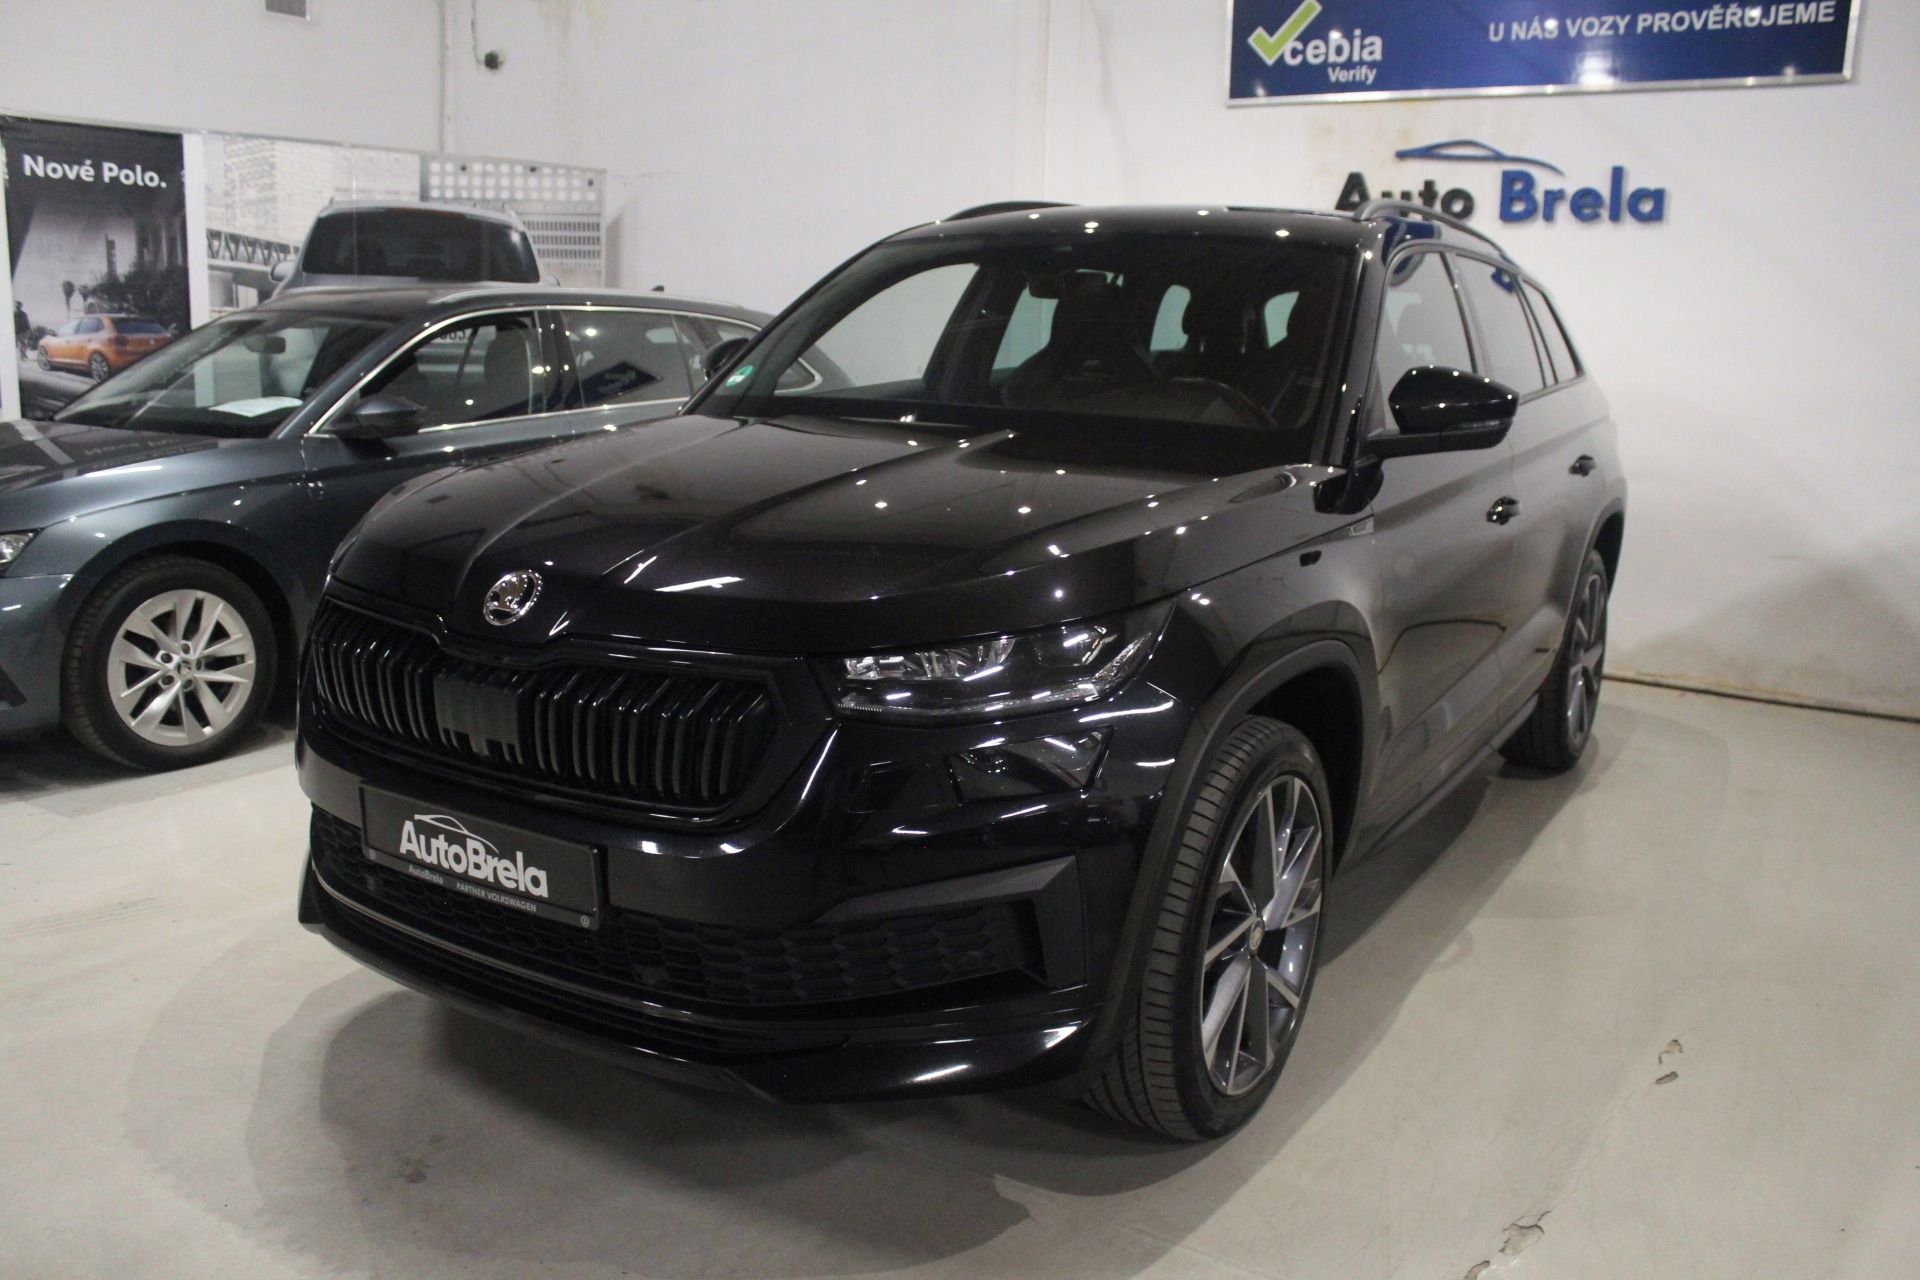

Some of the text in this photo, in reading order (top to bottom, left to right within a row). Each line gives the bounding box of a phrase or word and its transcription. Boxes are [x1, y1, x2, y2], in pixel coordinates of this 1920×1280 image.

[1488, 0, 1836, 42] U NÁS VOZY PROVĚŘUJEME
[1284, 29, 1383, 66] cebia
[1327, 66, 1377, 85] Verify
[22, 153, 167, 189] Nové Polo.
[1334, 165, 1666, 223] Ato Brela
[400, 820, 549, 898] AutoBrela
[456, 882, 486, 899] PARTNER
[486, 890, 537, 913] VOLKSWAGEN
